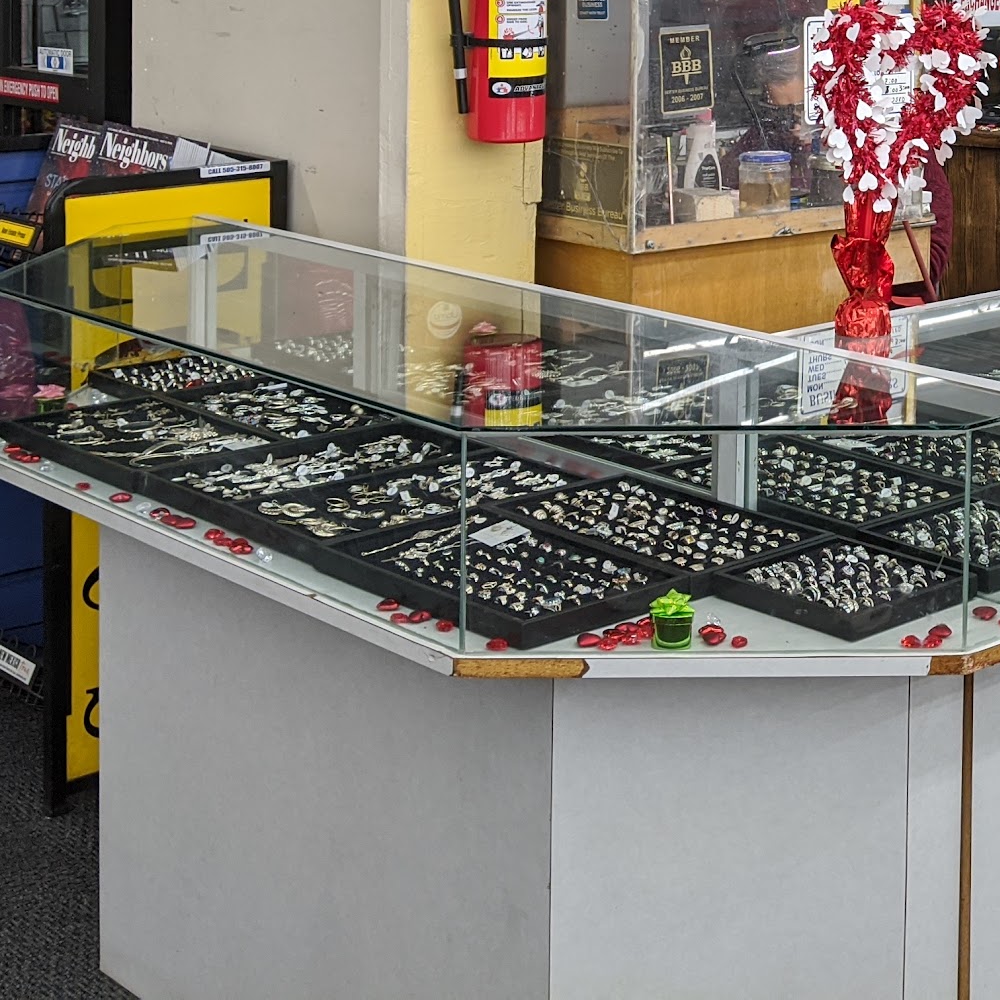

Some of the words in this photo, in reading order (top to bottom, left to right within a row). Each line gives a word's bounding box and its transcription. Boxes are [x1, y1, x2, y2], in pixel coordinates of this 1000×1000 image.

[670, 35, 700, 44] MEMBER
[671, 59, 702, 74] BBB
[29, 83, 41, 98] PUSH
[41, 85, 47, 99] TO
[47, 85, 59, 100] OPEN
[690, 93, 704, 102] 2007
[51, 128, 96, 162] Neighb
[99, 132, 169, 169] Neighbors
